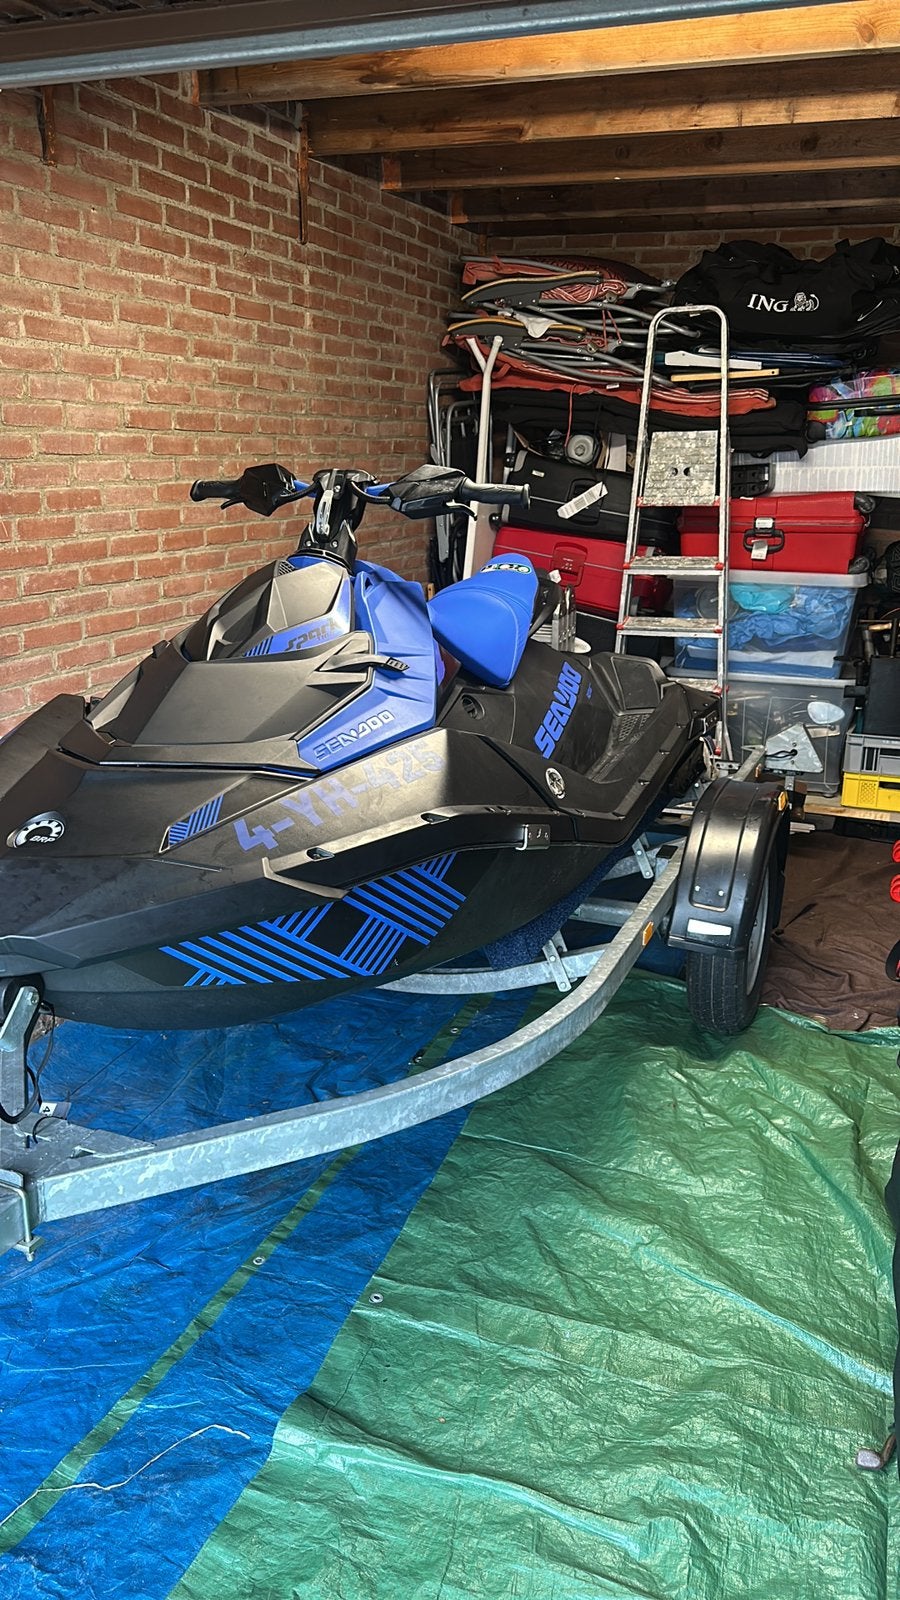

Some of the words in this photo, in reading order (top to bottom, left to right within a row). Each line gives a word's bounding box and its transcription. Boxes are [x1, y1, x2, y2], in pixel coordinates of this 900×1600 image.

[747, 293, 789, 312] ING
[232, 740, 445, 851] 4-YH-425
[29, 835, 56, 843] BRP
